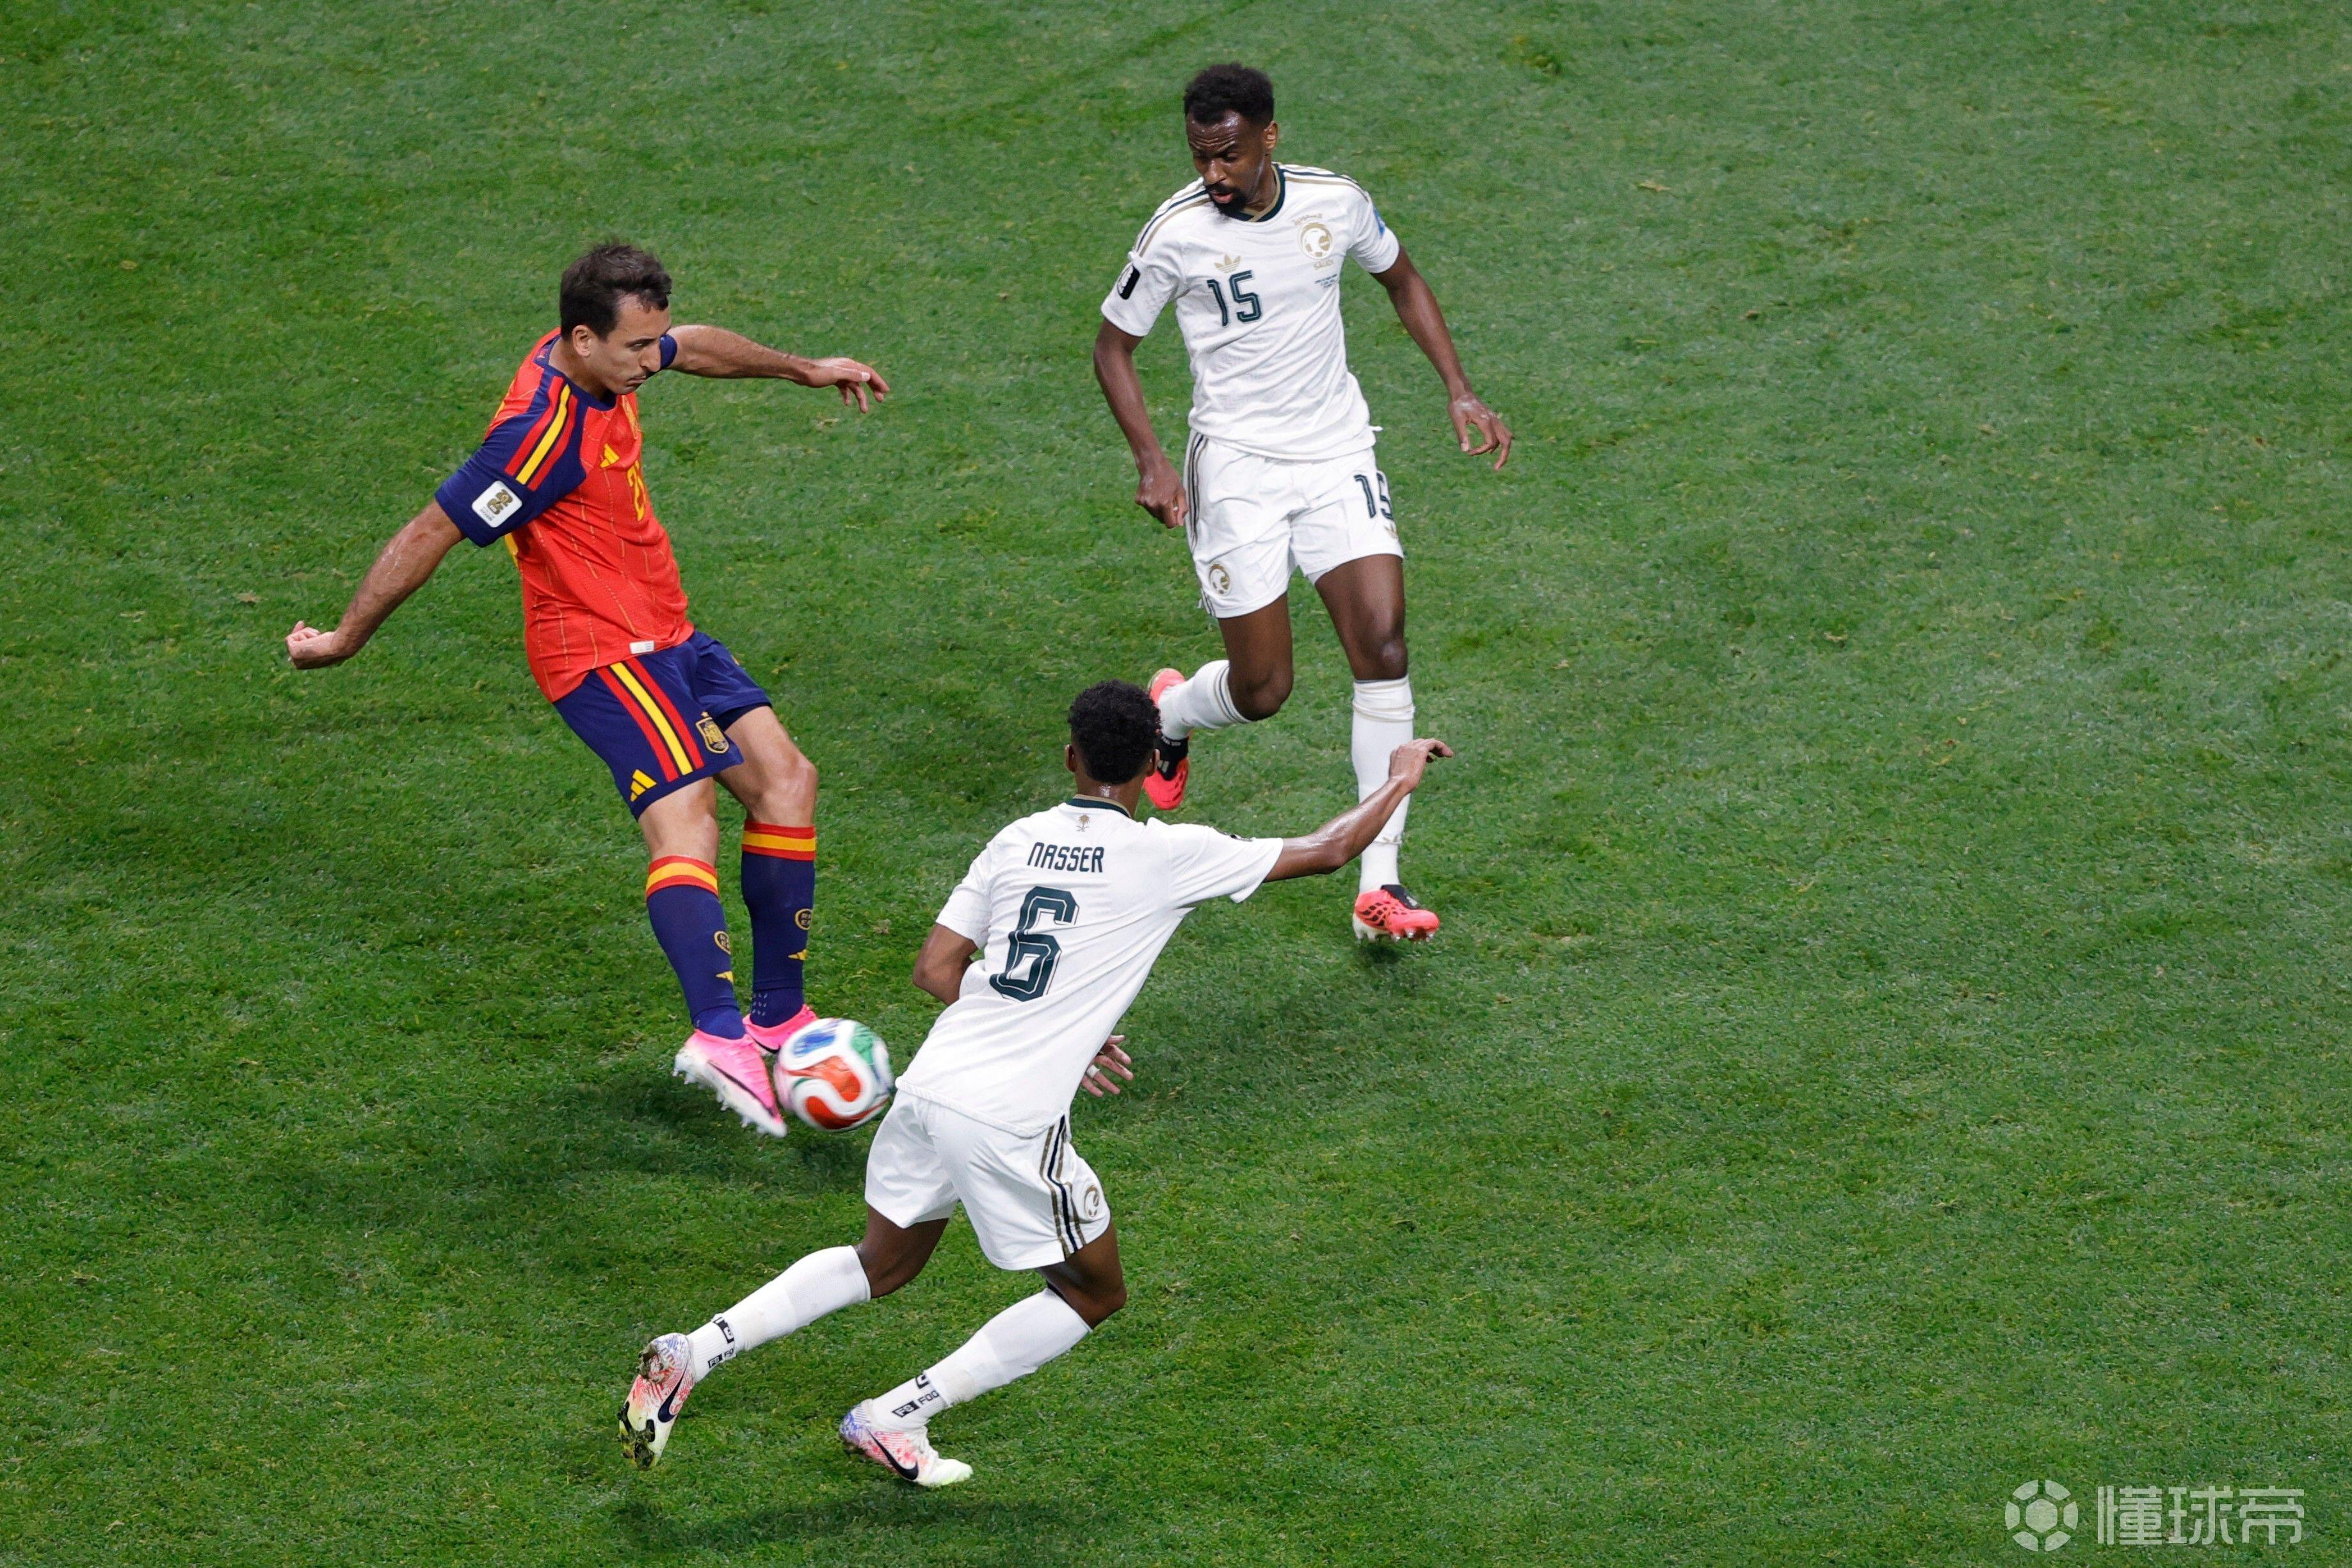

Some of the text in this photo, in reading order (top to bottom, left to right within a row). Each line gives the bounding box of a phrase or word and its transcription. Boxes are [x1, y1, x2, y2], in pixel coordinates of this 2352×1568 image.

[1206, 269, 1262, 327] 15
[1353, 472, 1394, 519] 15
[1027, 842, 1104, 873] NASSER
[989, 886, 1079, 1002] 6
